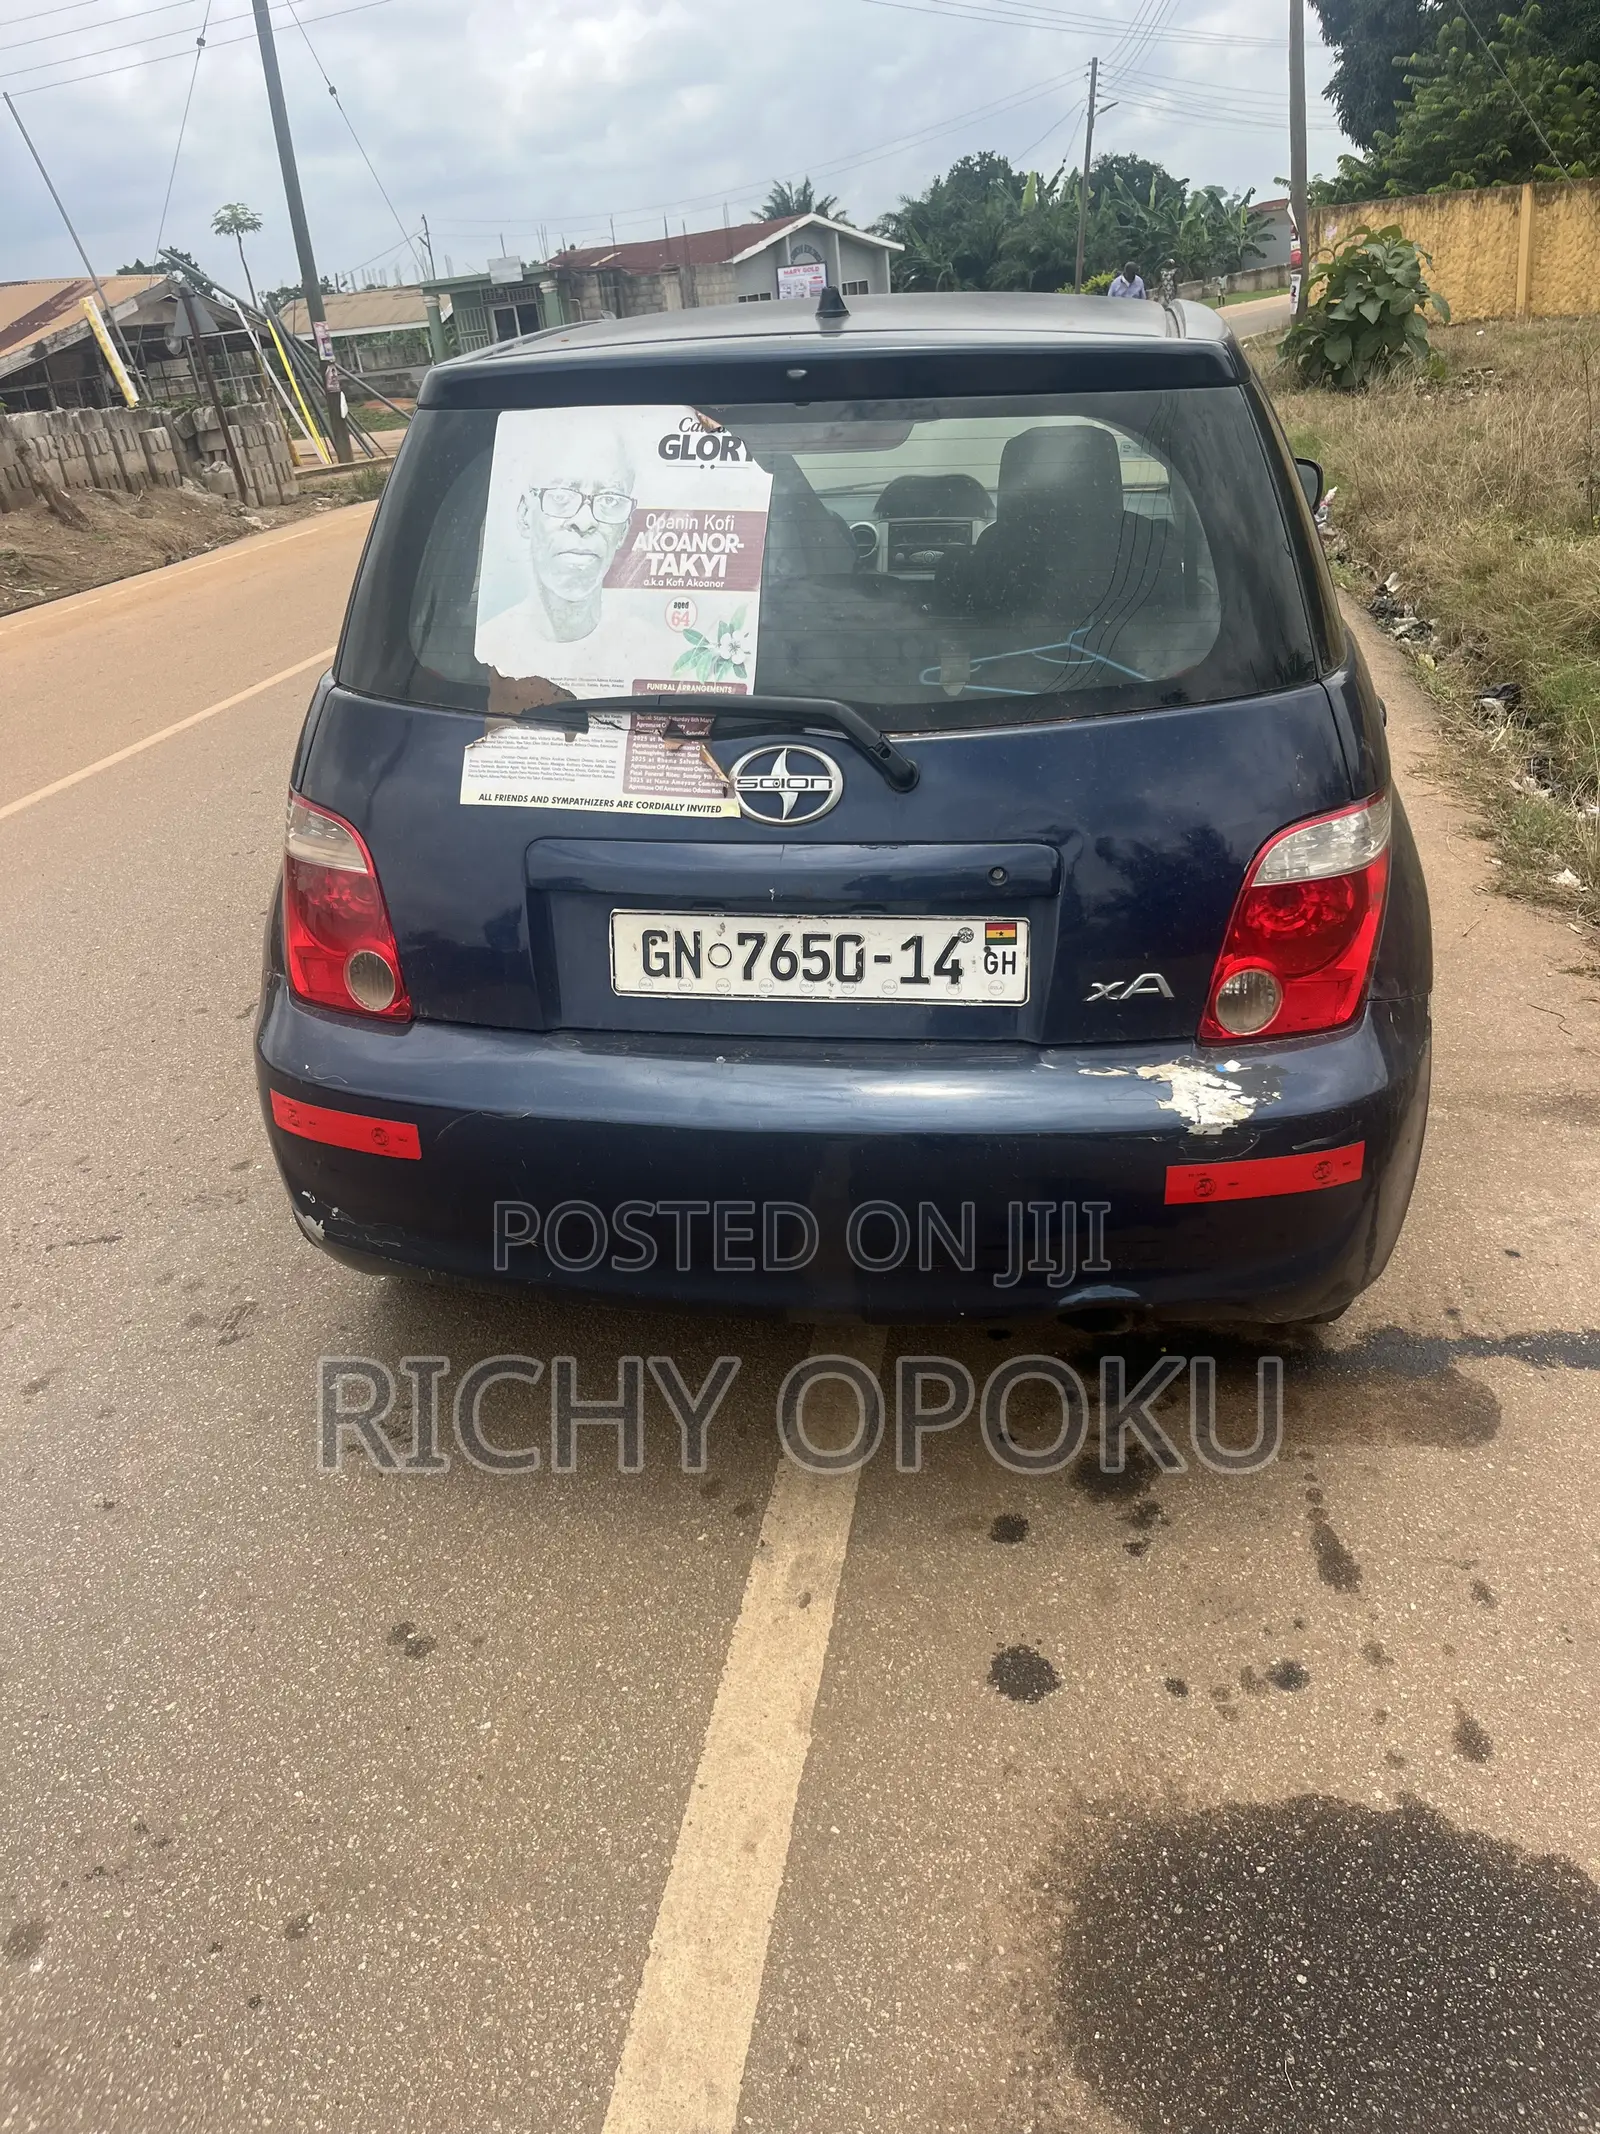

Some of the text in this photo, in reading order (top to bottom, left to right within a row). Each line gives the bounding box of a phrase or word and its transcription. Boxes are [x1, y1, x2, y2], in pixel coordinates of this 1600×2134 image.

[646, 513, 735, 531] Opanin Kofi
[632, 531, 744, 553] AKOANOR-
[645, 552, 727, 578] TAKYI
[643, 577, 725, 588] a.k.a Kofi Akoanor
[673, 601, 690, 610] aged
[671, 611, 690, 627] 64
[646, 683, 733, 694] FUNERAL ARRANGEMENTS
[478, 793, 722, 813] ALL FRIENDS AND SYMPATHIZERS ARE CORDIALLY INVITED
[641, 929, 701, 979] GN
[984, 951, 1016, 975] GH
[1085, 973, 1175, 1002] xA
